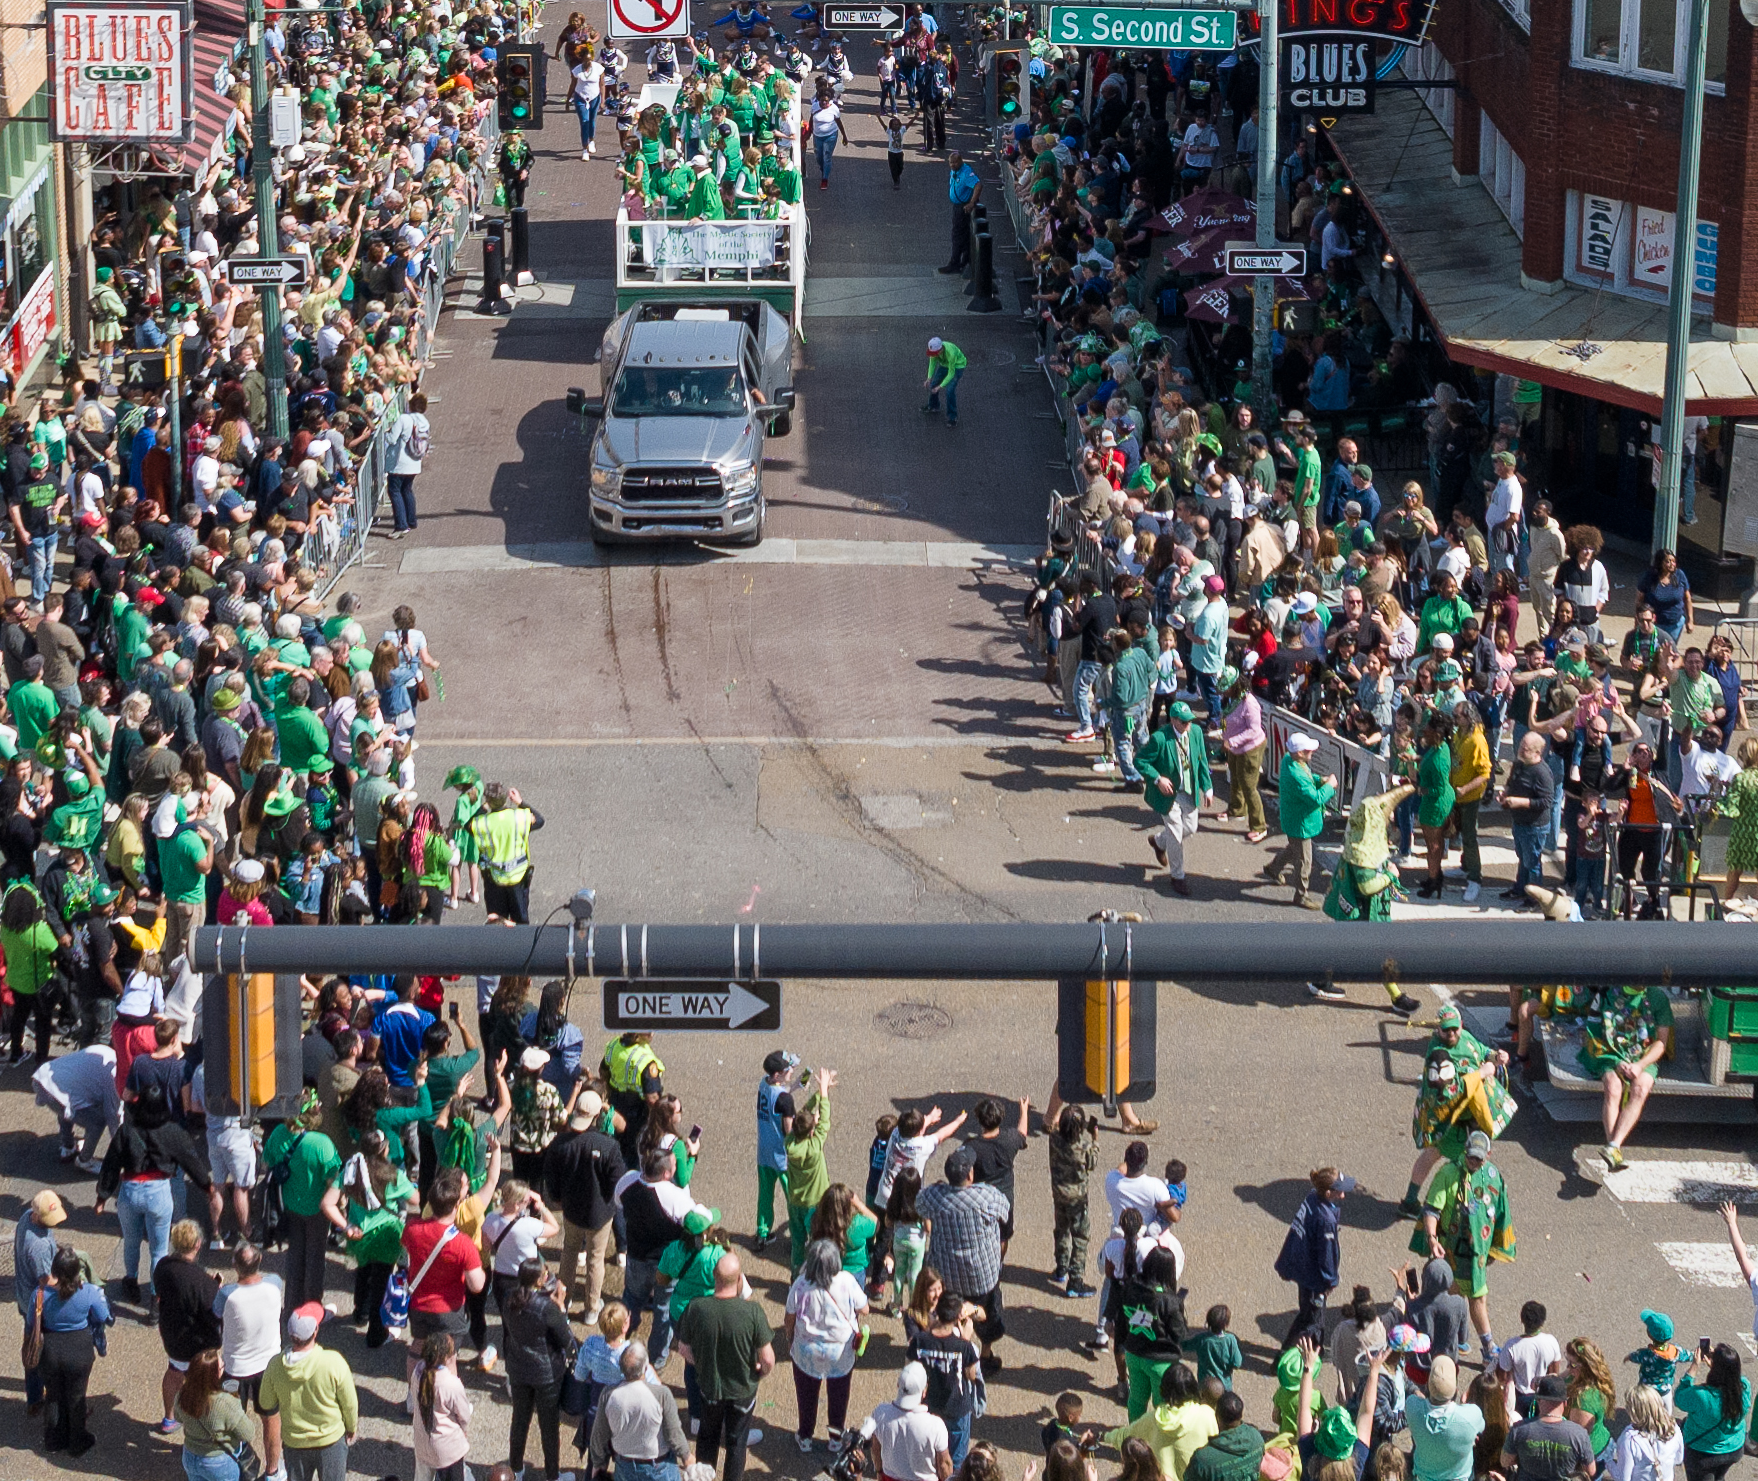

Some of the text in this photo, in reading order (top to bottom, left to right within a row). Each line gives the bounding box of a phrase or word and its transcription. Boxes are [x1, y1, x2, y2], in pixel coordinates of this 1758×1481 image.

[834, 11, 882, 23] ONE WAY
[62, 14, 173, 62] BLUES
[1061, 12, 1225, 45] S. Second St.
[88, 66, 147, 80] CITY
[1291, 43, 1369, 83] BLUES
[64, 66, 173, 130] CAFE
[1291, 88, 1367, 107] CLUB
[691, 230, 772, 241] The Mystic Society
[1587, 199, 1613, 268] SALADS
[1642, 215, 1666, 237] Fried
[719, 240, 744, 248] of the
[1637, 240, 1670, 264] Chicken
[704, 250, 759, 263] Memphi
[1236, 257, 1282, 267] ONE WAY
[1695, 223, 1719, 292] GUMBO
[236, 267, 282, 278] ONE WAY
[649, 477, 693, 487] RAM
[625, 995, 728, 1016] ONE WAY
